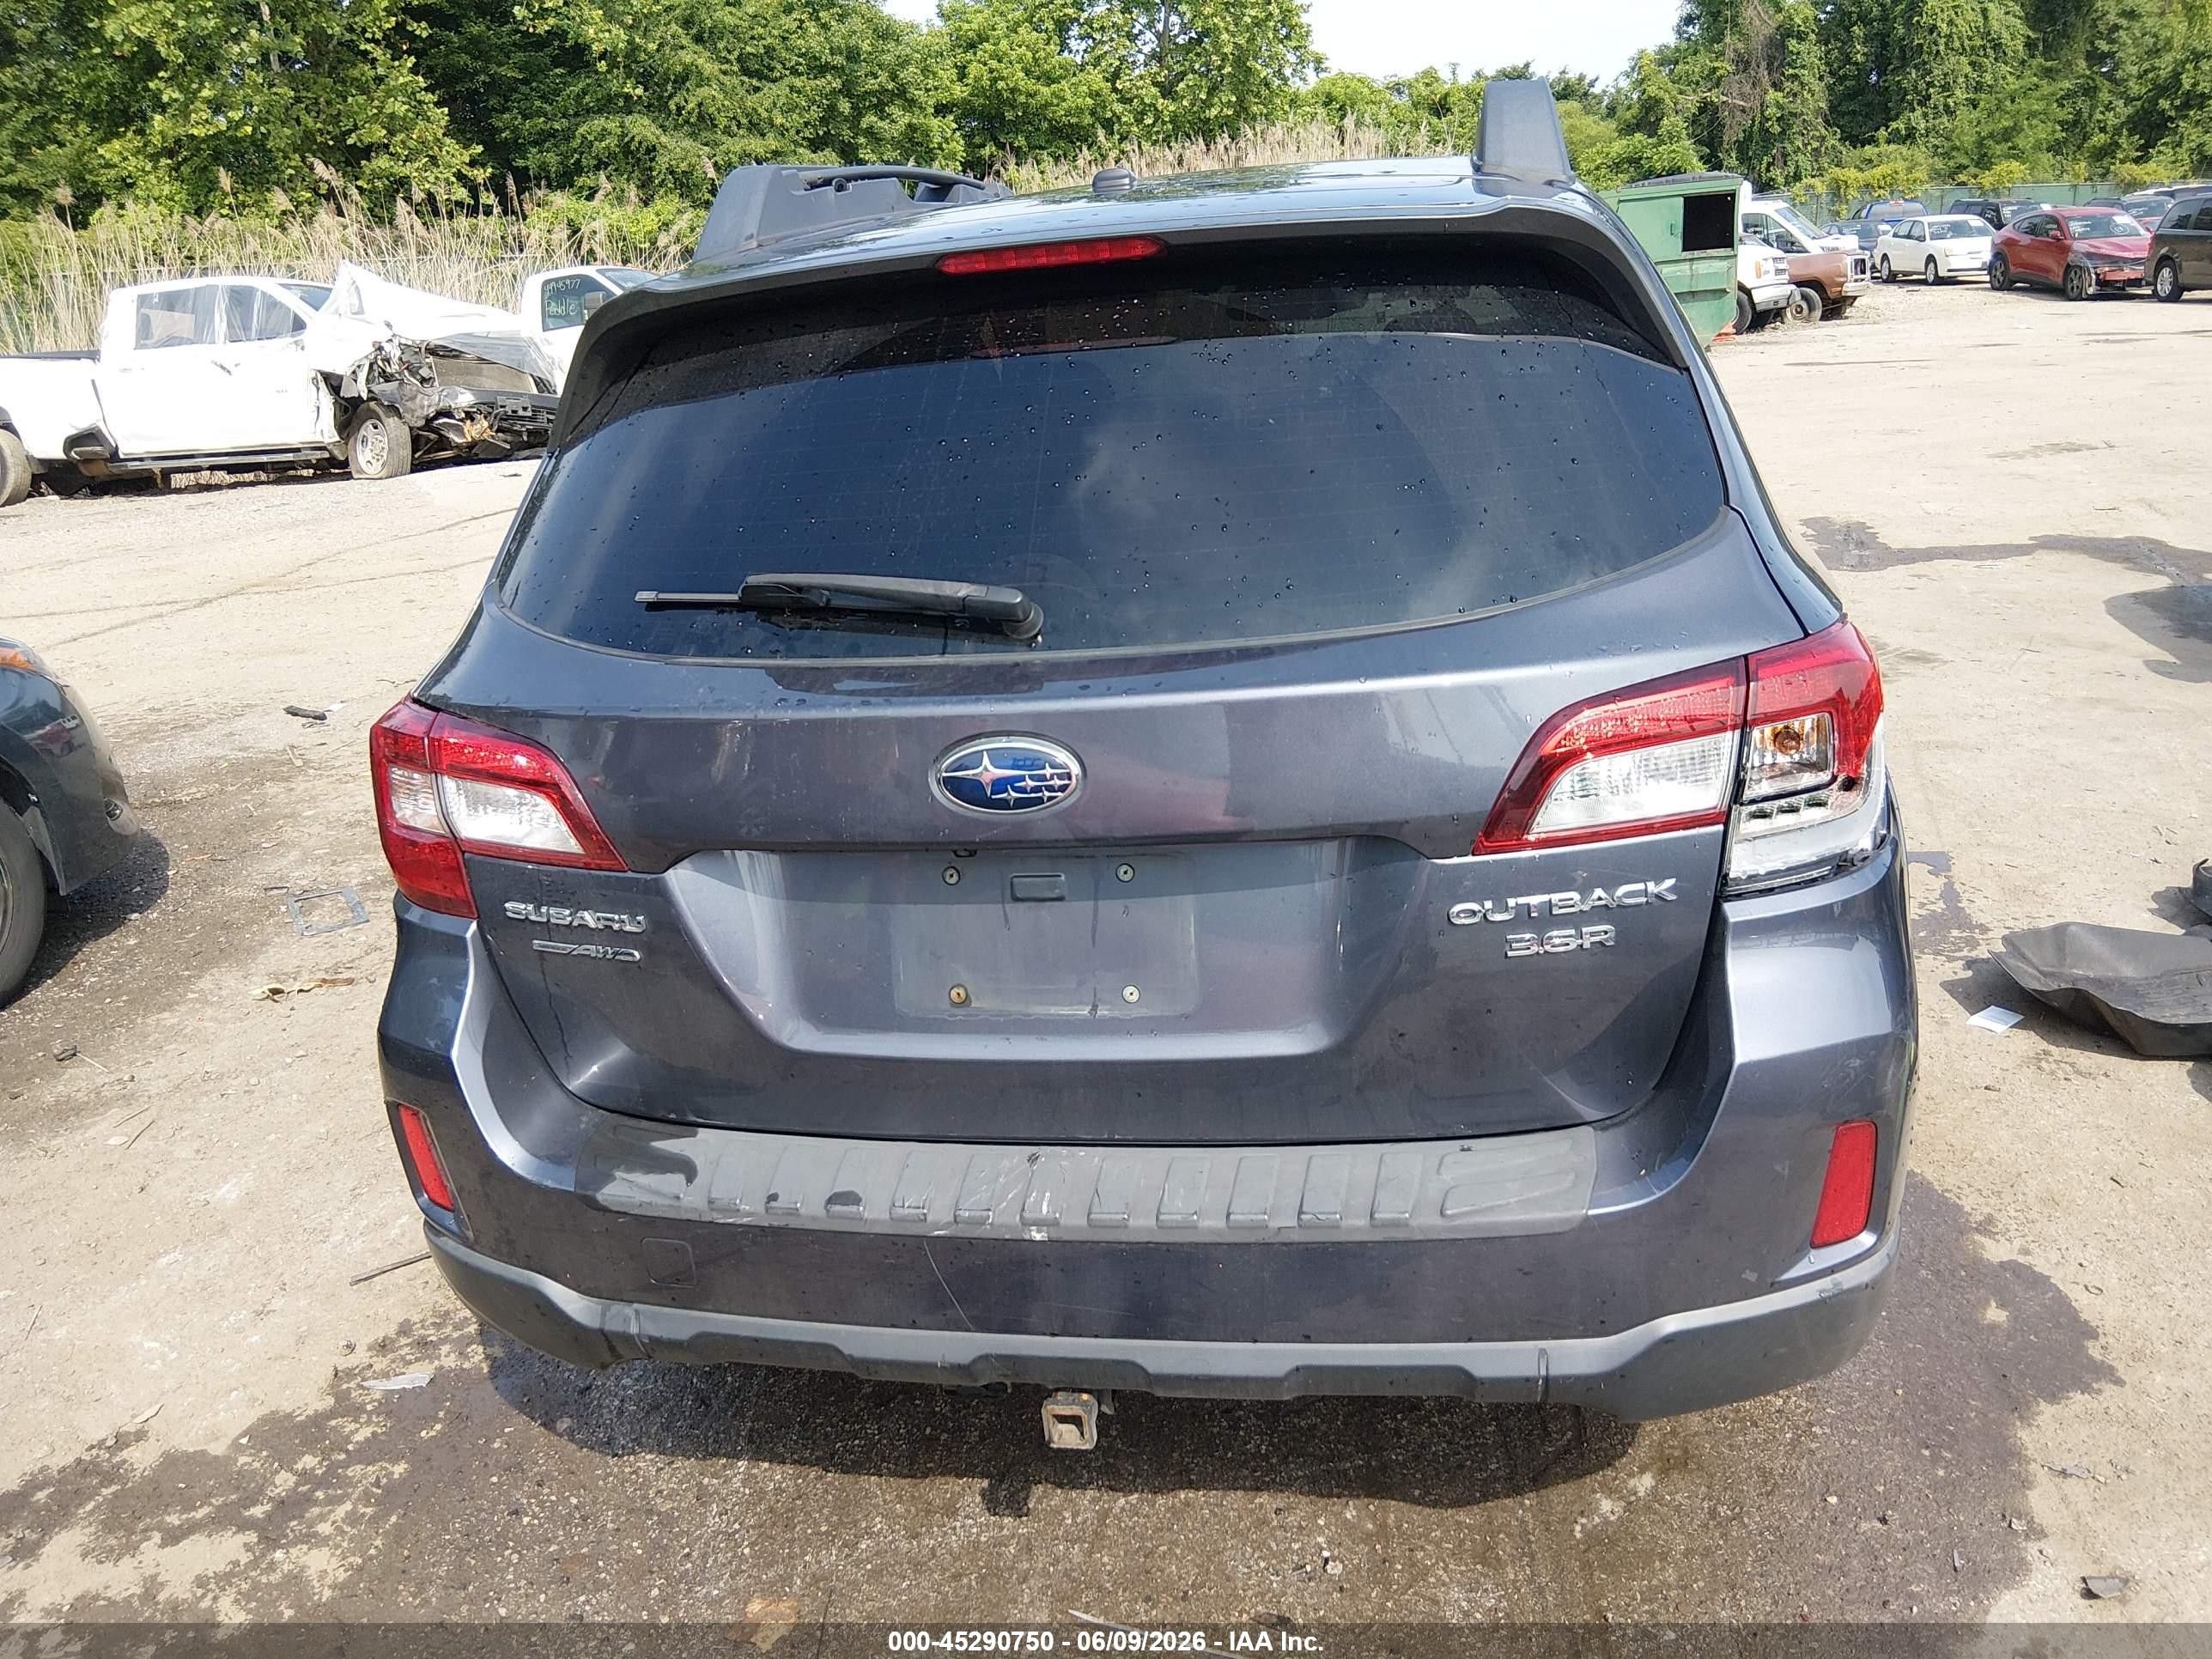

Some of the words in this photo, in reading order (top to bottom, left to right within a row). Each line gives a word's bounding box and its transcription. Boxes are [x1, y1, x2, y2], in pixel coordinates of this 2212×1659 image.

[544, 297, 578, 319] Peddle
[503, 901, 647, 933] SUBARU
[1448, 878, 1677, 925] OUTBACK
[569, 944, 641, 963] AWD
[1504, 924, 1616, 958] 3.6R
